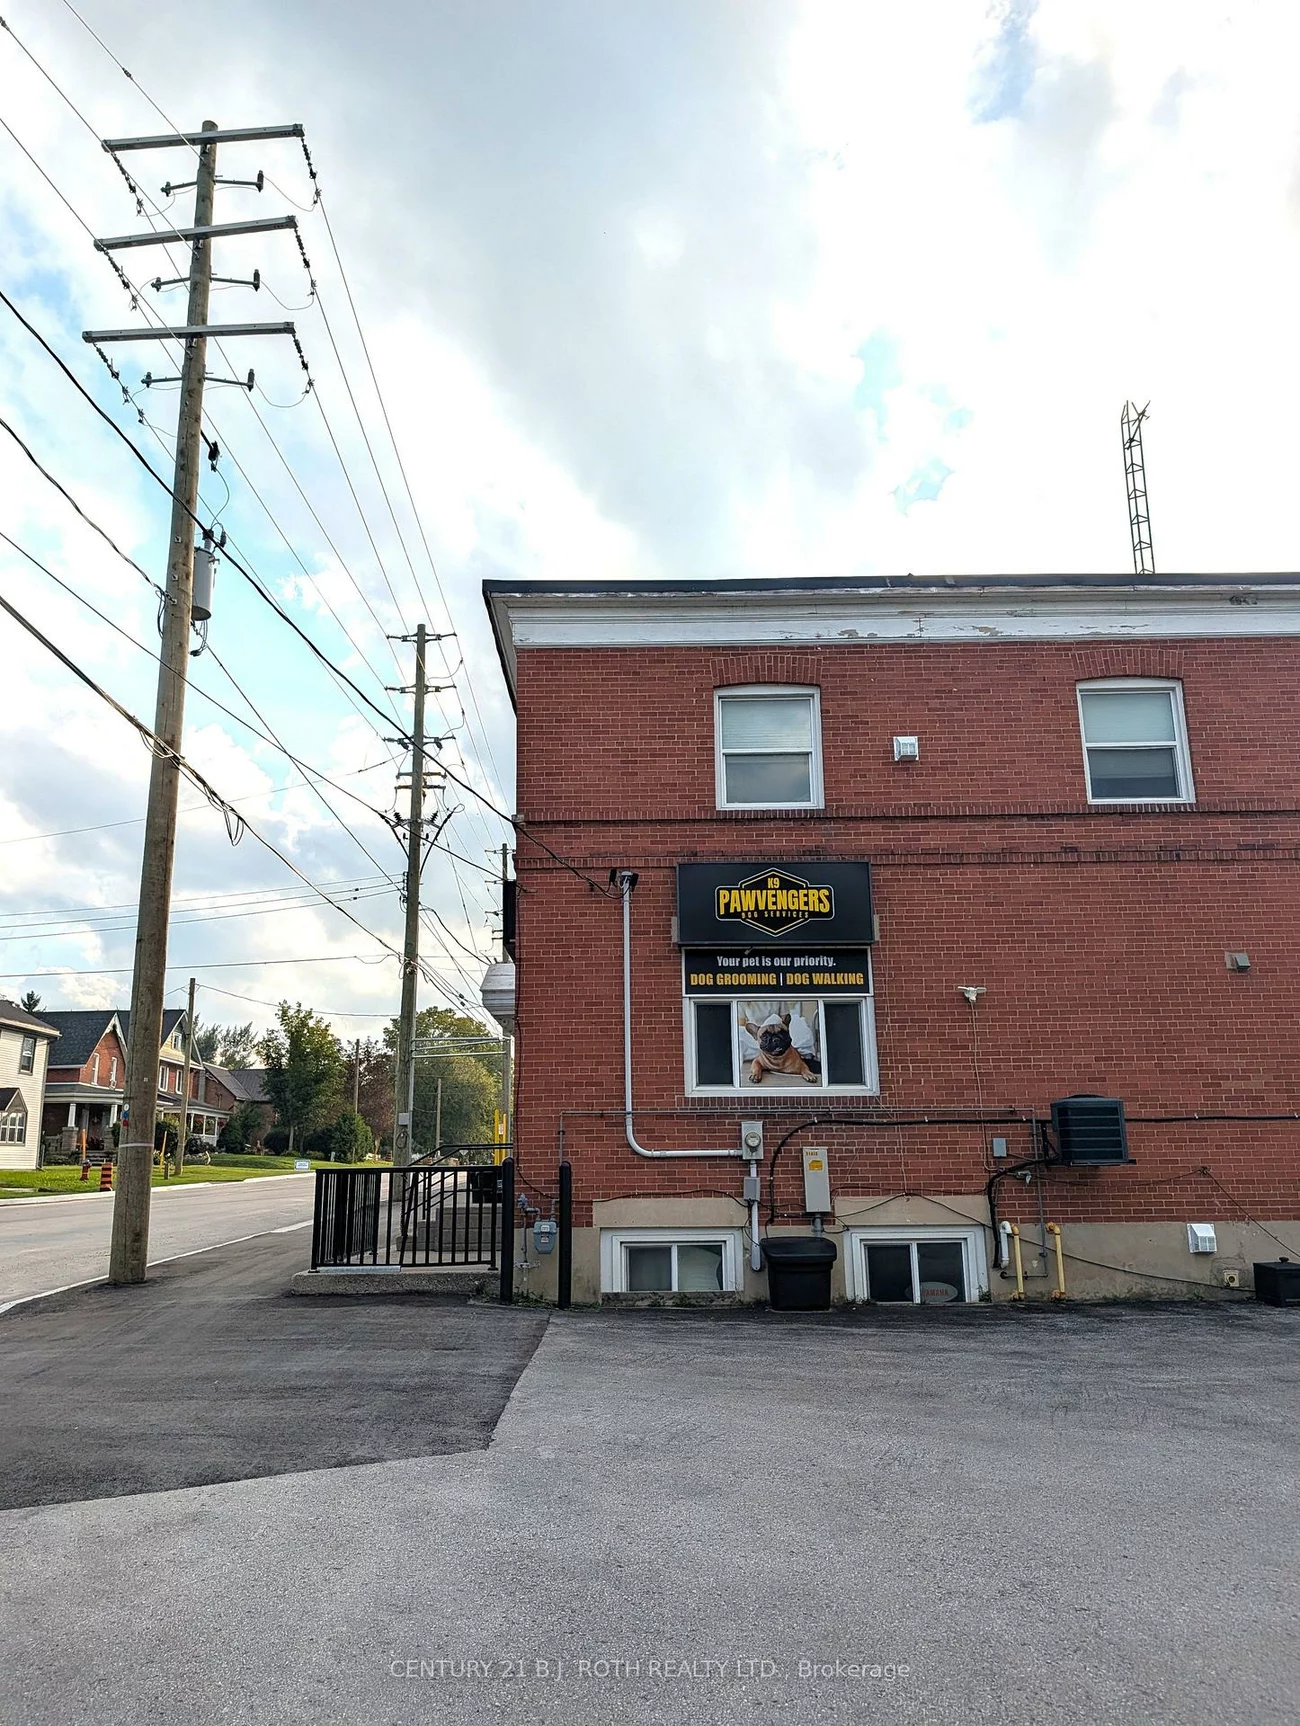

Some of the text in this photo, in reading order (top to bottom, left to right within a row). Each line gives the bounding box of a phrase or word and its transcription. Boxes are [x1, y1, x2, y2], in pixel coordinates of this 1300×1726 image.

[767, 877, 780, 889] K9
[719, 889, 831, 915] PAWVENGERS
[741, 911, 809, 919] DOG SERVICES
[716, 955, 837, 968] Your pet is our priority.
[690, 972, 865, 986] DOG GROOMING DOG WALKING
